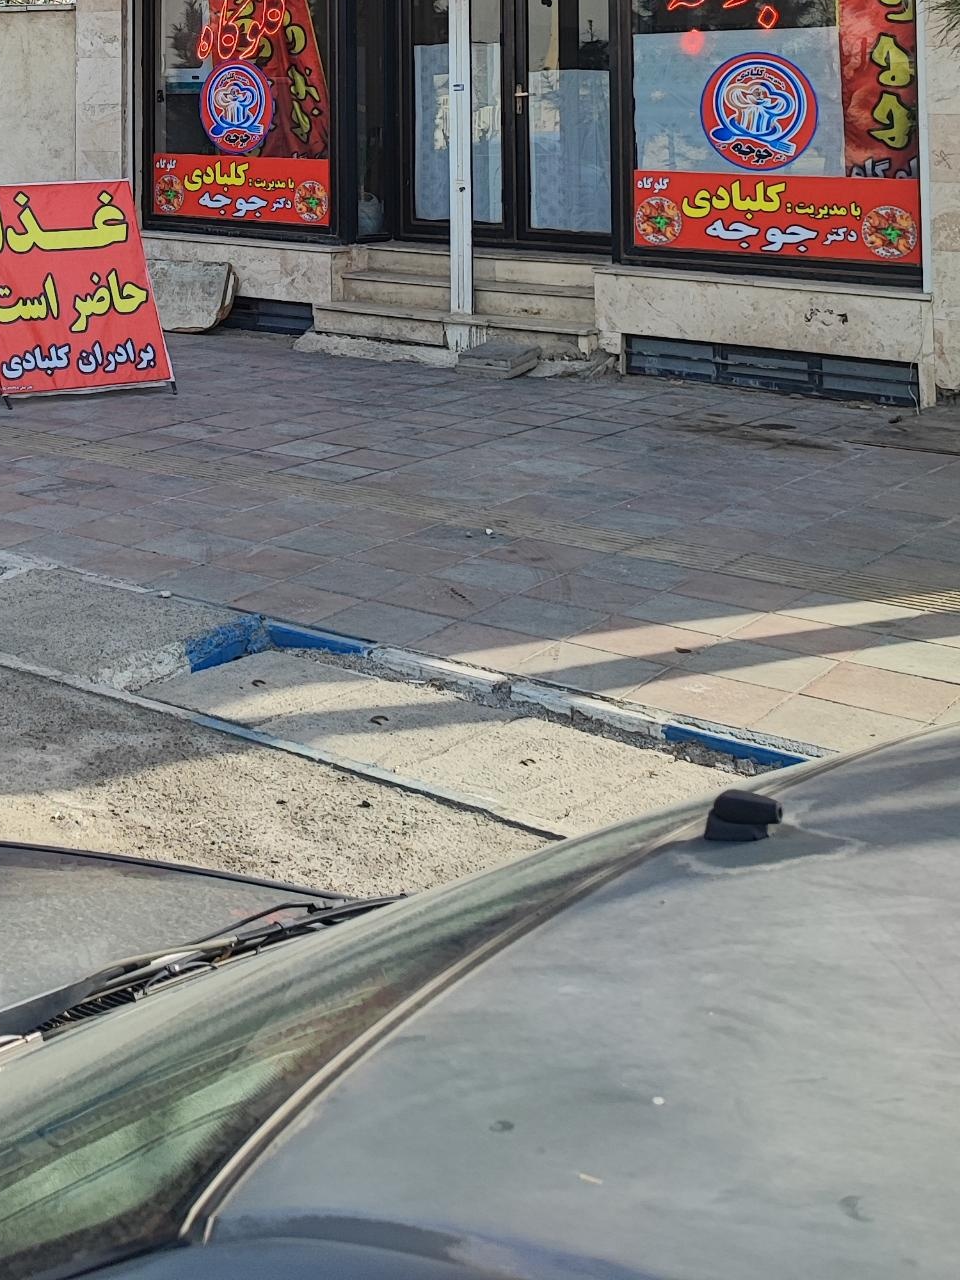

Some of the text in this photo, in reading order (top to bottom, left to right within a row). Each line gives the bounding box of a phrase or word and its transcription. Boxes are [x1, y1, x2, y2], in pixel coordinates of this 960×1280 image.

[731, 142, 774, 165] جوجه
[184, 161, 249, 192] کلبادی
[637, 177, 669, 193] گلوگاه
[198, 192, 268, 217] جوجه
[682, 178, 787, 219] کلبادی
[850, 202, 862, 220] با
[705, 218, 857, 253] دکتر جوجه
[69, 268, 149, 333] حاضر
[1, 337, 156, 381] برادران کلبادی
